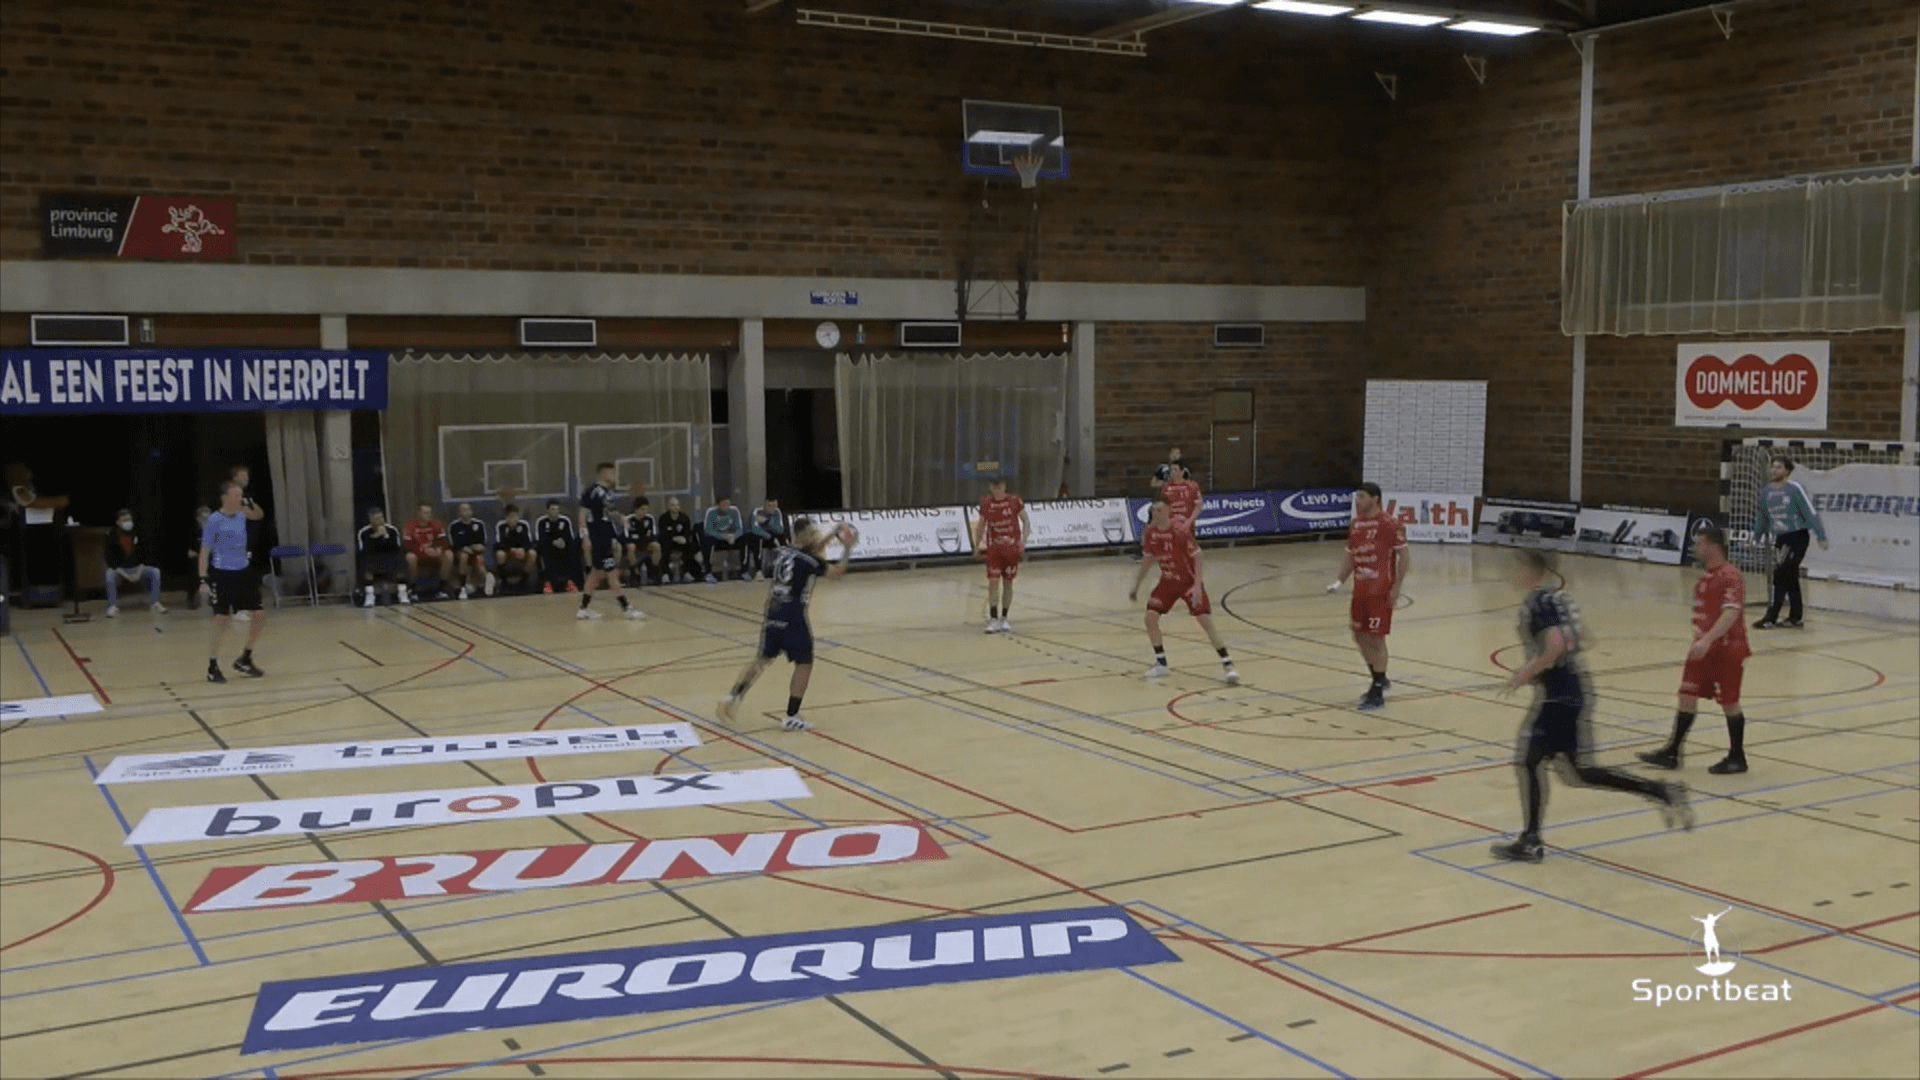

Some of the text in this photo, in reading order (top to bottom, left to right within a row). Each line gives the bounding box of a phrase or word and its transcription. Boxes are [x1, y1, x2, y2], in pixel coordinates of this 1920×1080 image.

[50, 208, 118, 223] provincie
[51, 223, 114, 242] Limburg
[0, 358, 370, 404] AL EEN FEEST IN NEERPELT
[1695, 370, 1809, 395] DOMMELHOF
[1222, 498, 1265, 511] Projects
[1301, 493, 1329, 505] LEVO
[1449, 529, 1469, 539] bois
[1368, 617, 1381, 630] 27
[204, 773, 725, 837] buropix
[191, 823, 921, 911] BRUNO
[263, 917, 1130, 1032] EUROQUIP
